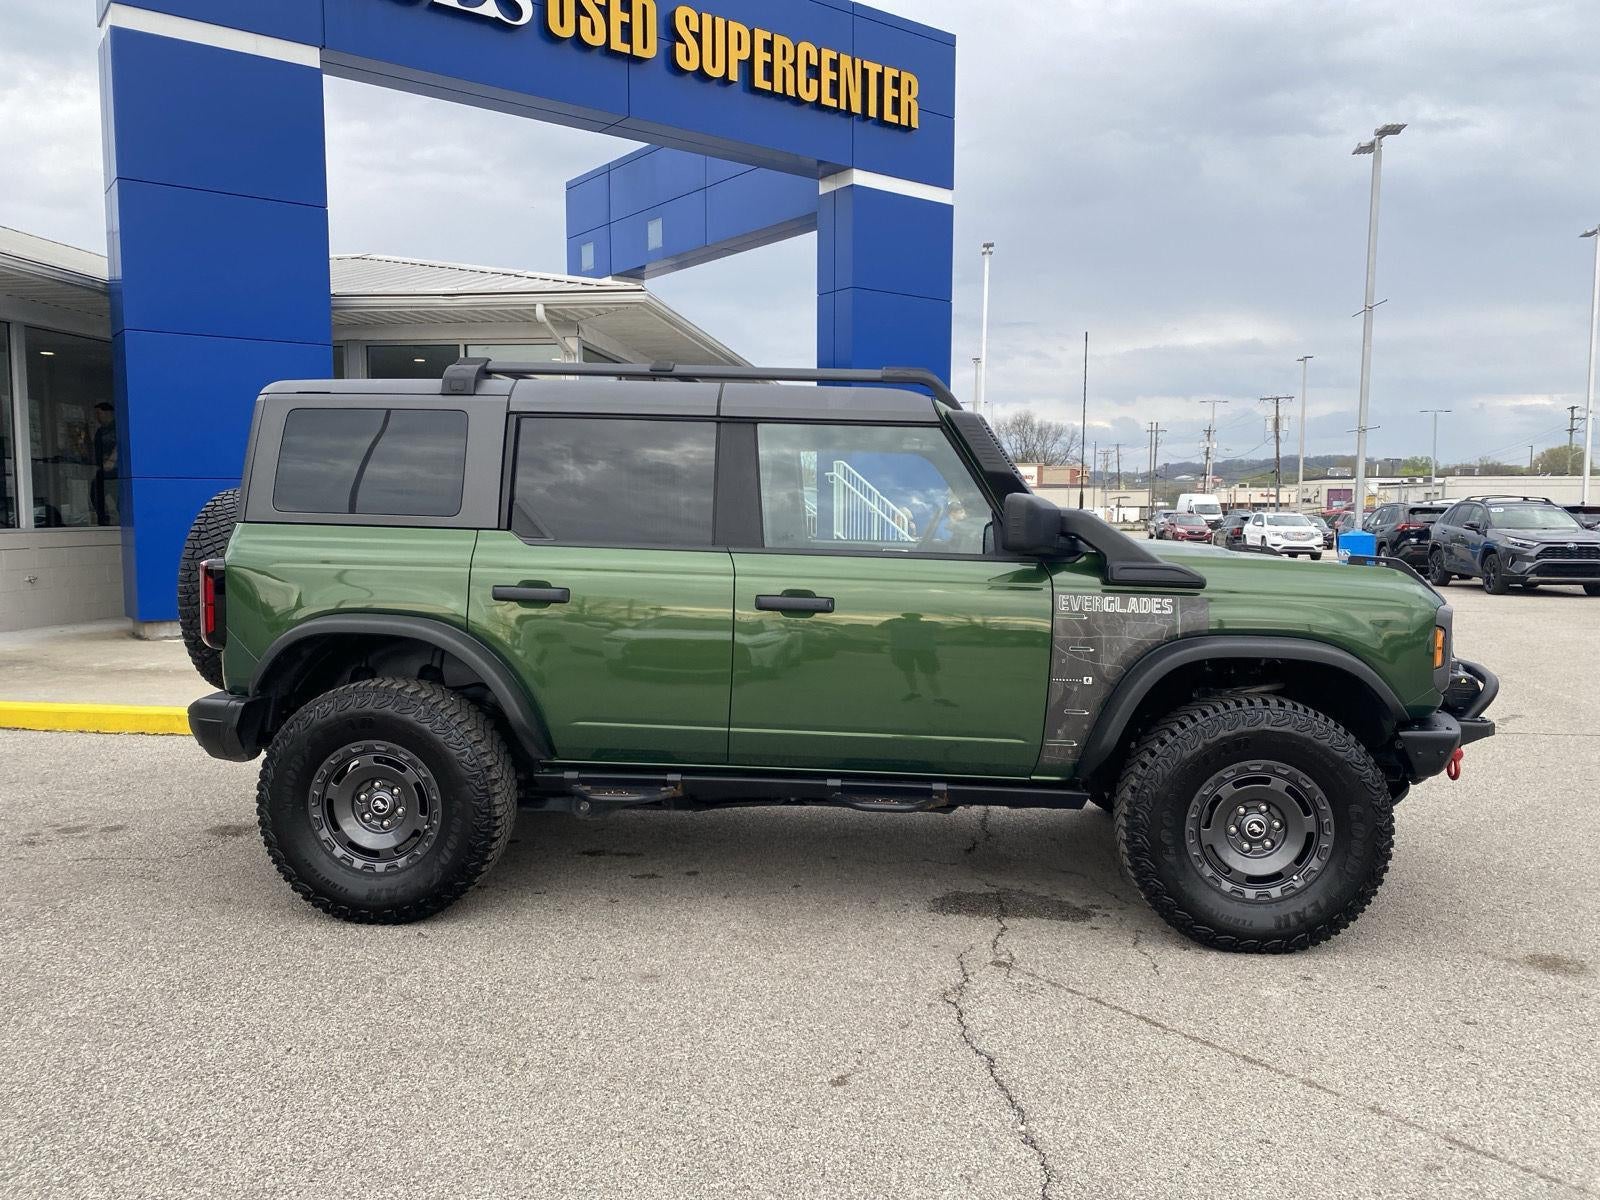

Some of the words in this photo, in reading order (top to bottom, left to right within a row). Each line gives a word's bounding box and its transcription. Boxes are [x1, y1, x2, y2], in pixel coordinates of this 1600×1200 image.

[547, 0, 657, 59] USED
[673, 5, 919, 129] SUPERCENTER
[1058, 594, 1173, 614] EVERGLADES
